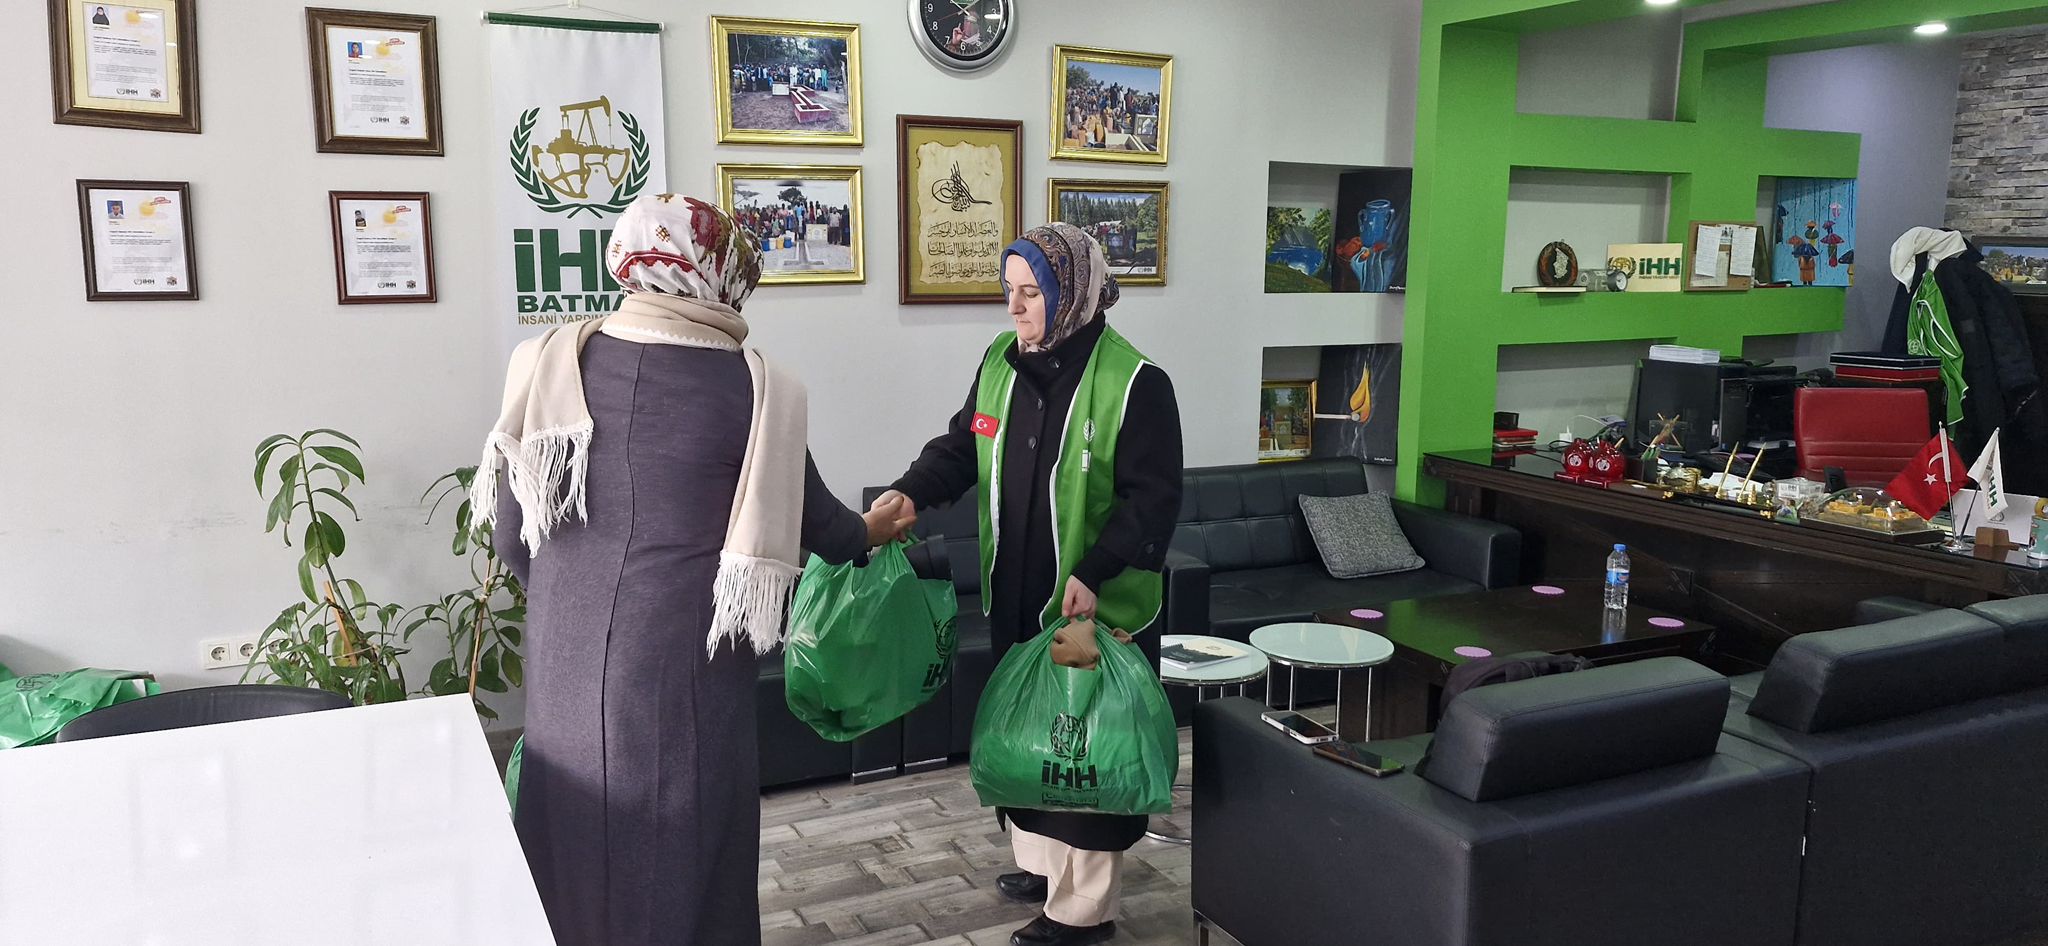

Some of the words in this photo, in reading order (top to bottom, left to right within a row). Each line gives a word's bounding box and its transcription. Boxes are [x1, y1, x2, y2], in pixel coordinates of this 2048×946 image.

[927, 3, 933, 12] 9
[932, 21, 938, 30] 8
[986, 26, 992, 34] 4
[944, 36, 950, 45] 7
[960, 42, 966, 50] 6
[517, 294, 627, 313] BATMA
[518, 313, 557, 326] İNSANİ
